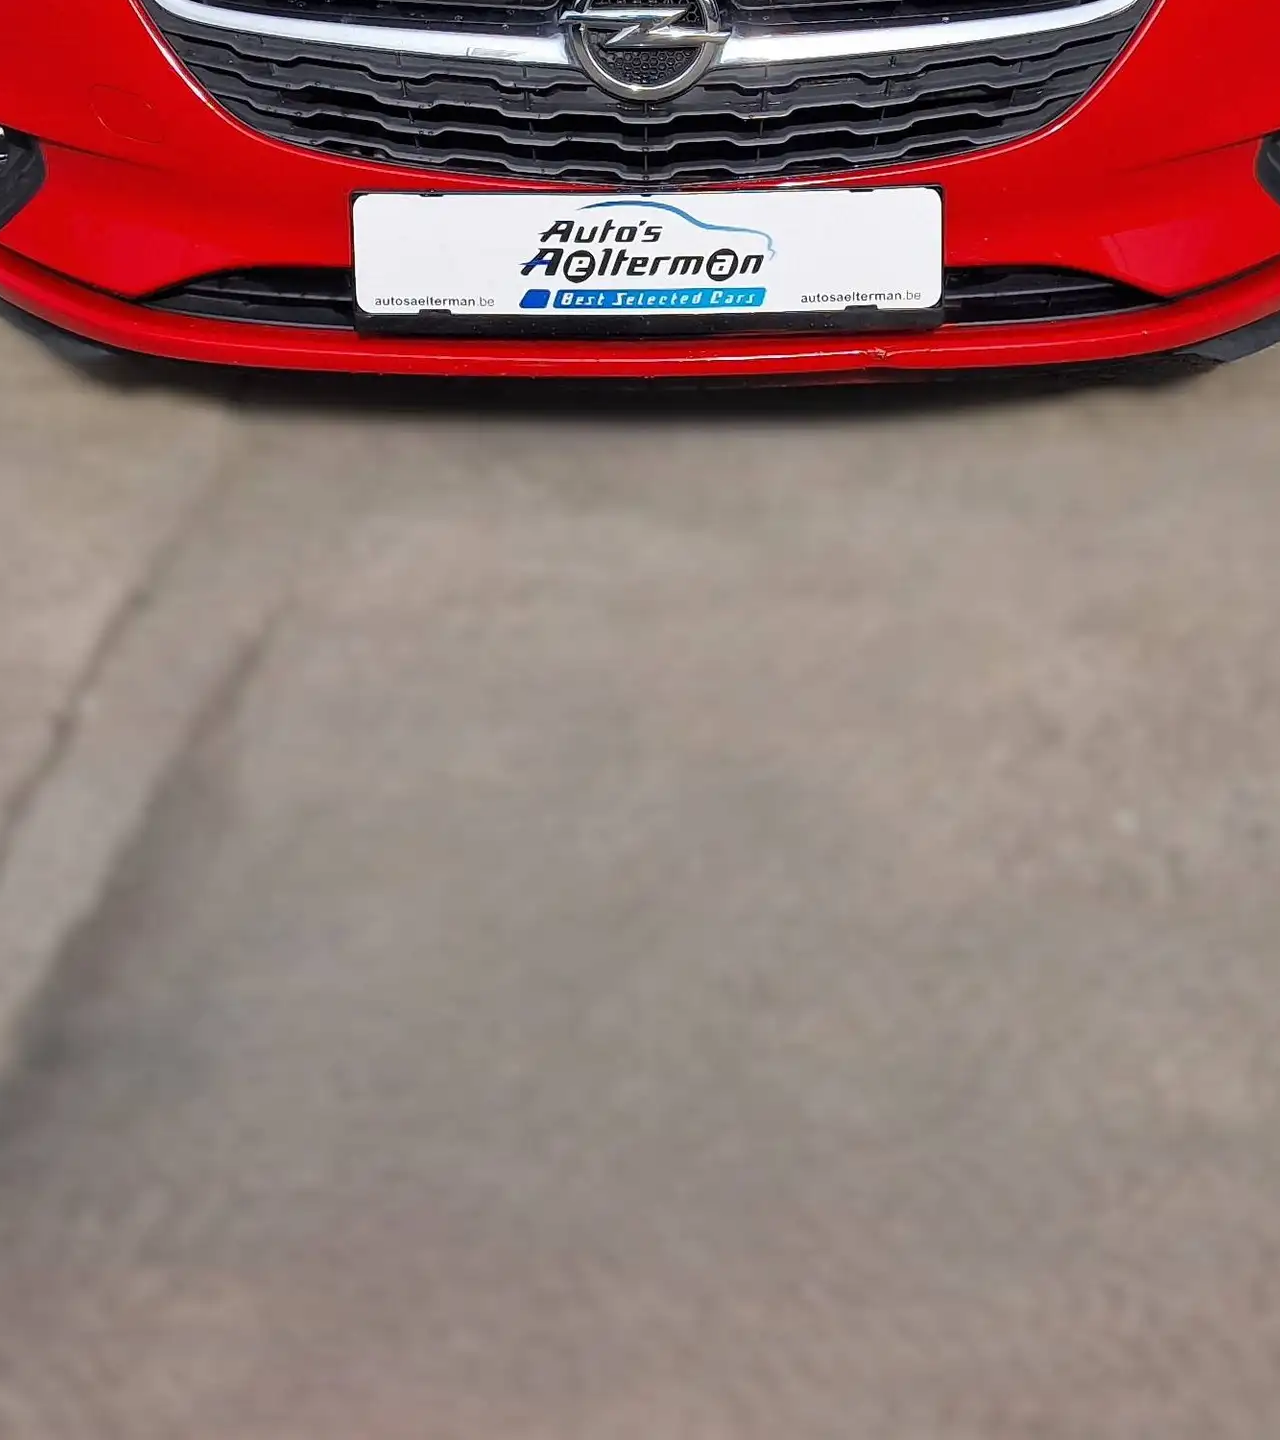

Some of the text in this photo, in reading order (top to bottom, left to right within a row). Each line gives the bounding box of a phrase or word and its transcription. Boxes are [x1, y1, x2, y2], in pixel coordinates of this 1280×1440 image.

[538, 219, 663, 243] Auto's
[518, 247, 765, 283] Aelterman
[374, 296, 495, 307] autosaelterman.be
[560, 290, 756, 306] Best Selected Cars
[800, 290, 921, 303] autosaelterman.be
